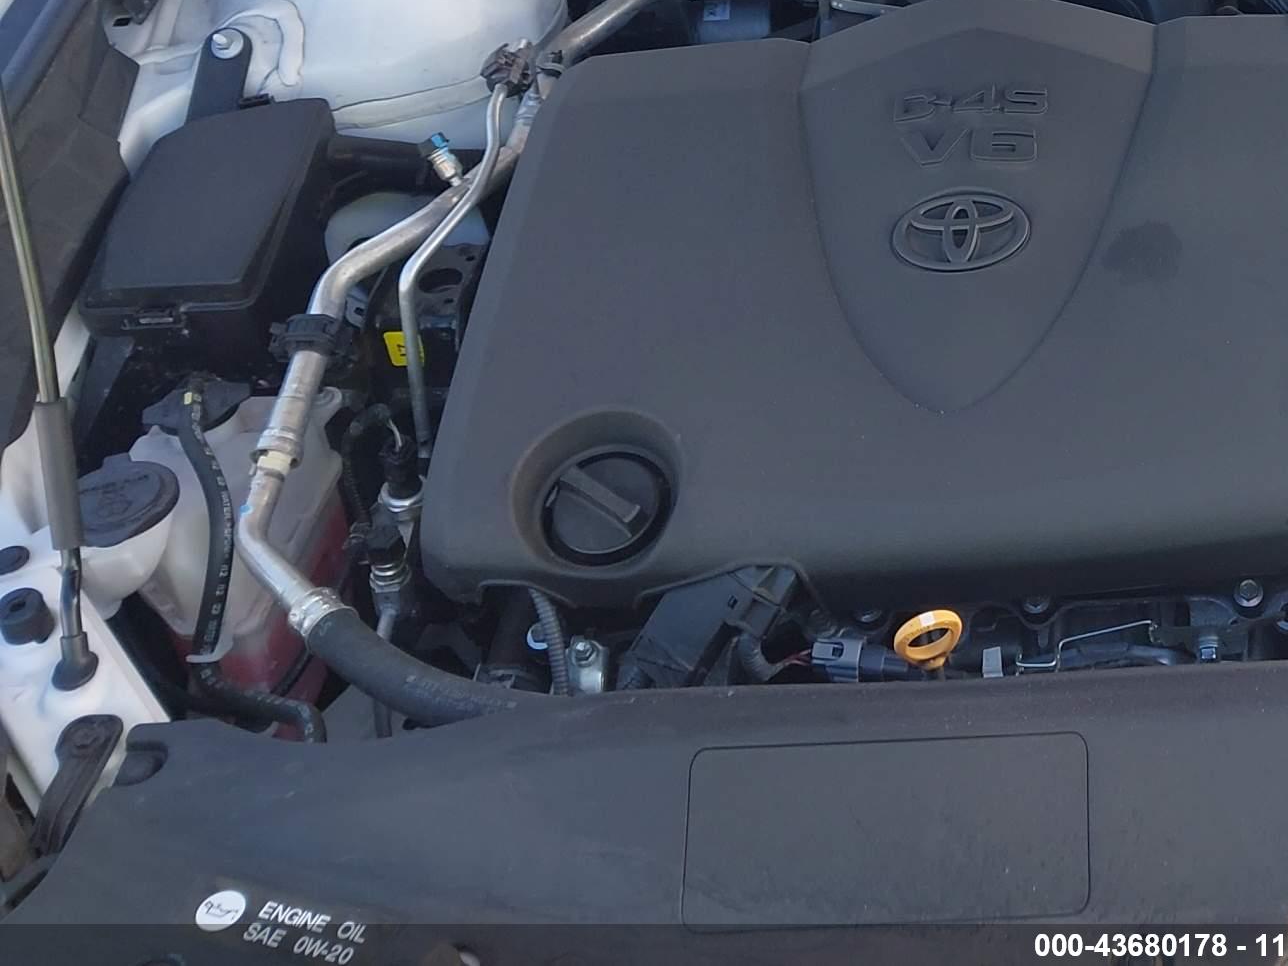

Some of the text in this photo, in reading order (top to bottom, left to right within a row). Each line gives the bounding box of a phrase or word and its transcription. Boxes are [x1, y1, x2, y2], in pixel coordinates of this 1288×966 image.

[894, 83, 1048, 123] D-4S
[899, 127, 1038, 167] V6
[258, 901, 366, 944] ENGINE OIL
[243, 922, 354, 965] SAE 0W-20
